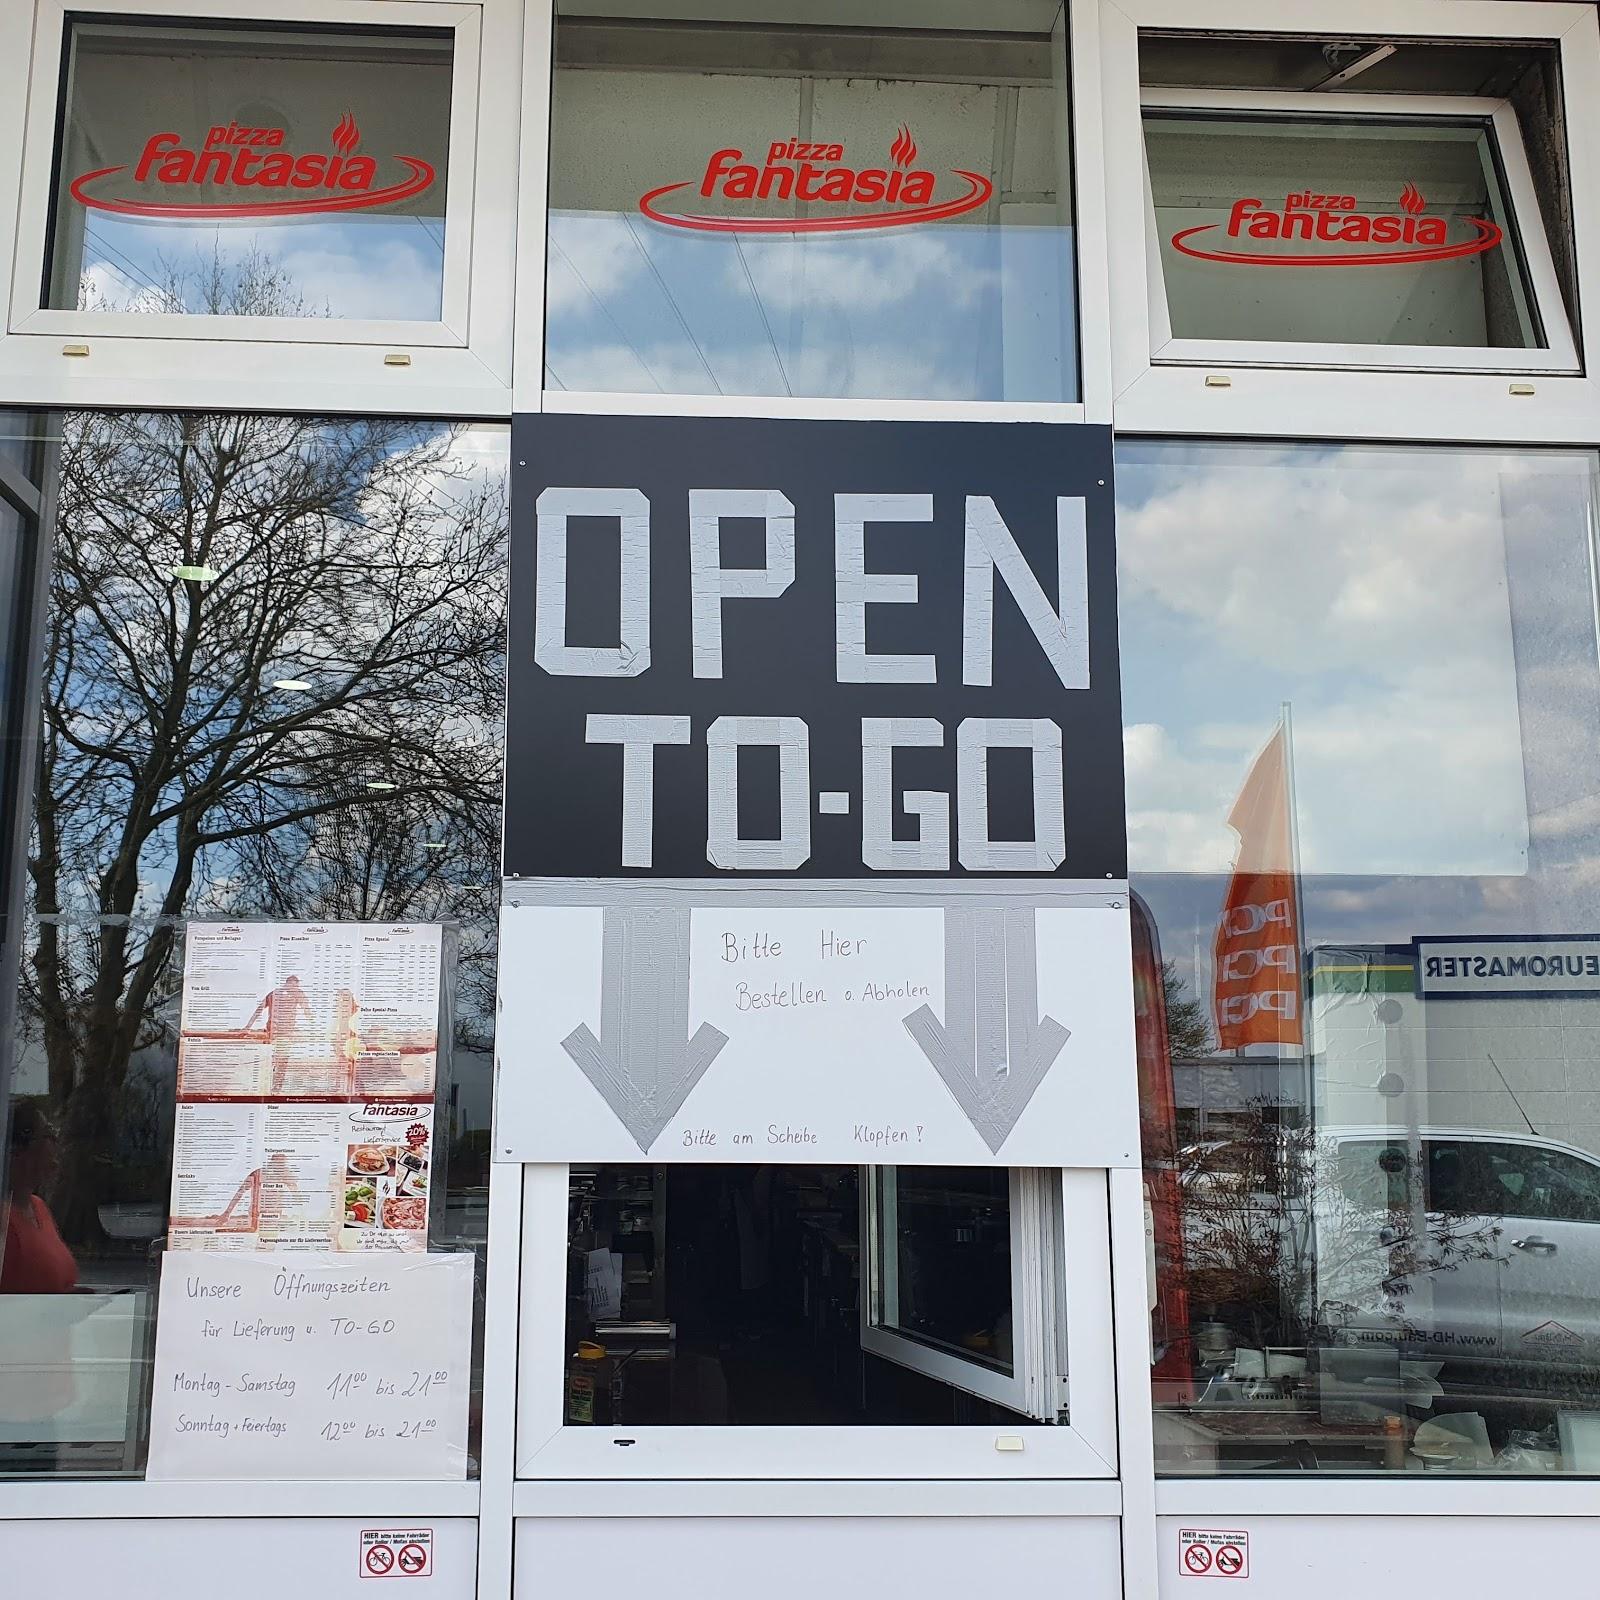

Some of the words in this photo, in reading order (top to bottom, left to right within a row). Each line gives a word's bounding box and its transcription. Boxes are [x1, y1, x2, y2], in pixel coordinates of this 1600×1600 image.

[206, 121, 286, 151] pizza
[134, 132, 378, 190] fantasia
[767, 137, 844, 166] pizza
[700, 149, 936, 204] fantasia
[1285, 190, 1356, 212] pizza
[1227, 198, 1448, 245] fantasia
[534, 487, 1091, 690] OPEN
[585, 714, 1066, 871] TO-GO
[721, 932, 782, 963] Bitte
[821, 929, 867, 960] Hier
[735, 981, 827, 1011] Bestellen
[862, 981, 930, 1002] Abholen
[683, 1129, 717, 1147] Bitte
[733, 1134, 753, 1144] am
[767, 1124, 818, 1144] Scheibe
[854, 1125, 908, 1147] Klopfen
[187, 1276, 242, 1298] Unsere
[274, 1266, 392, 1301] Öffnungszeiten
[201, 1318, 223, 1338] für
[233, 1319, 296, 1342] Lieferung
[330, 1317, 395, 1336] TO-GO
[173, 1373, 221, 1398] Montag
[235, 1372, 296, 1397] Samstag
[375, 1378, 395, 1396] bis
[175, 1414, 229, 1439] Sonntag
[241, 1416, 287, 1436] Feiertags
[364, 1423, 385, 1439] bis
